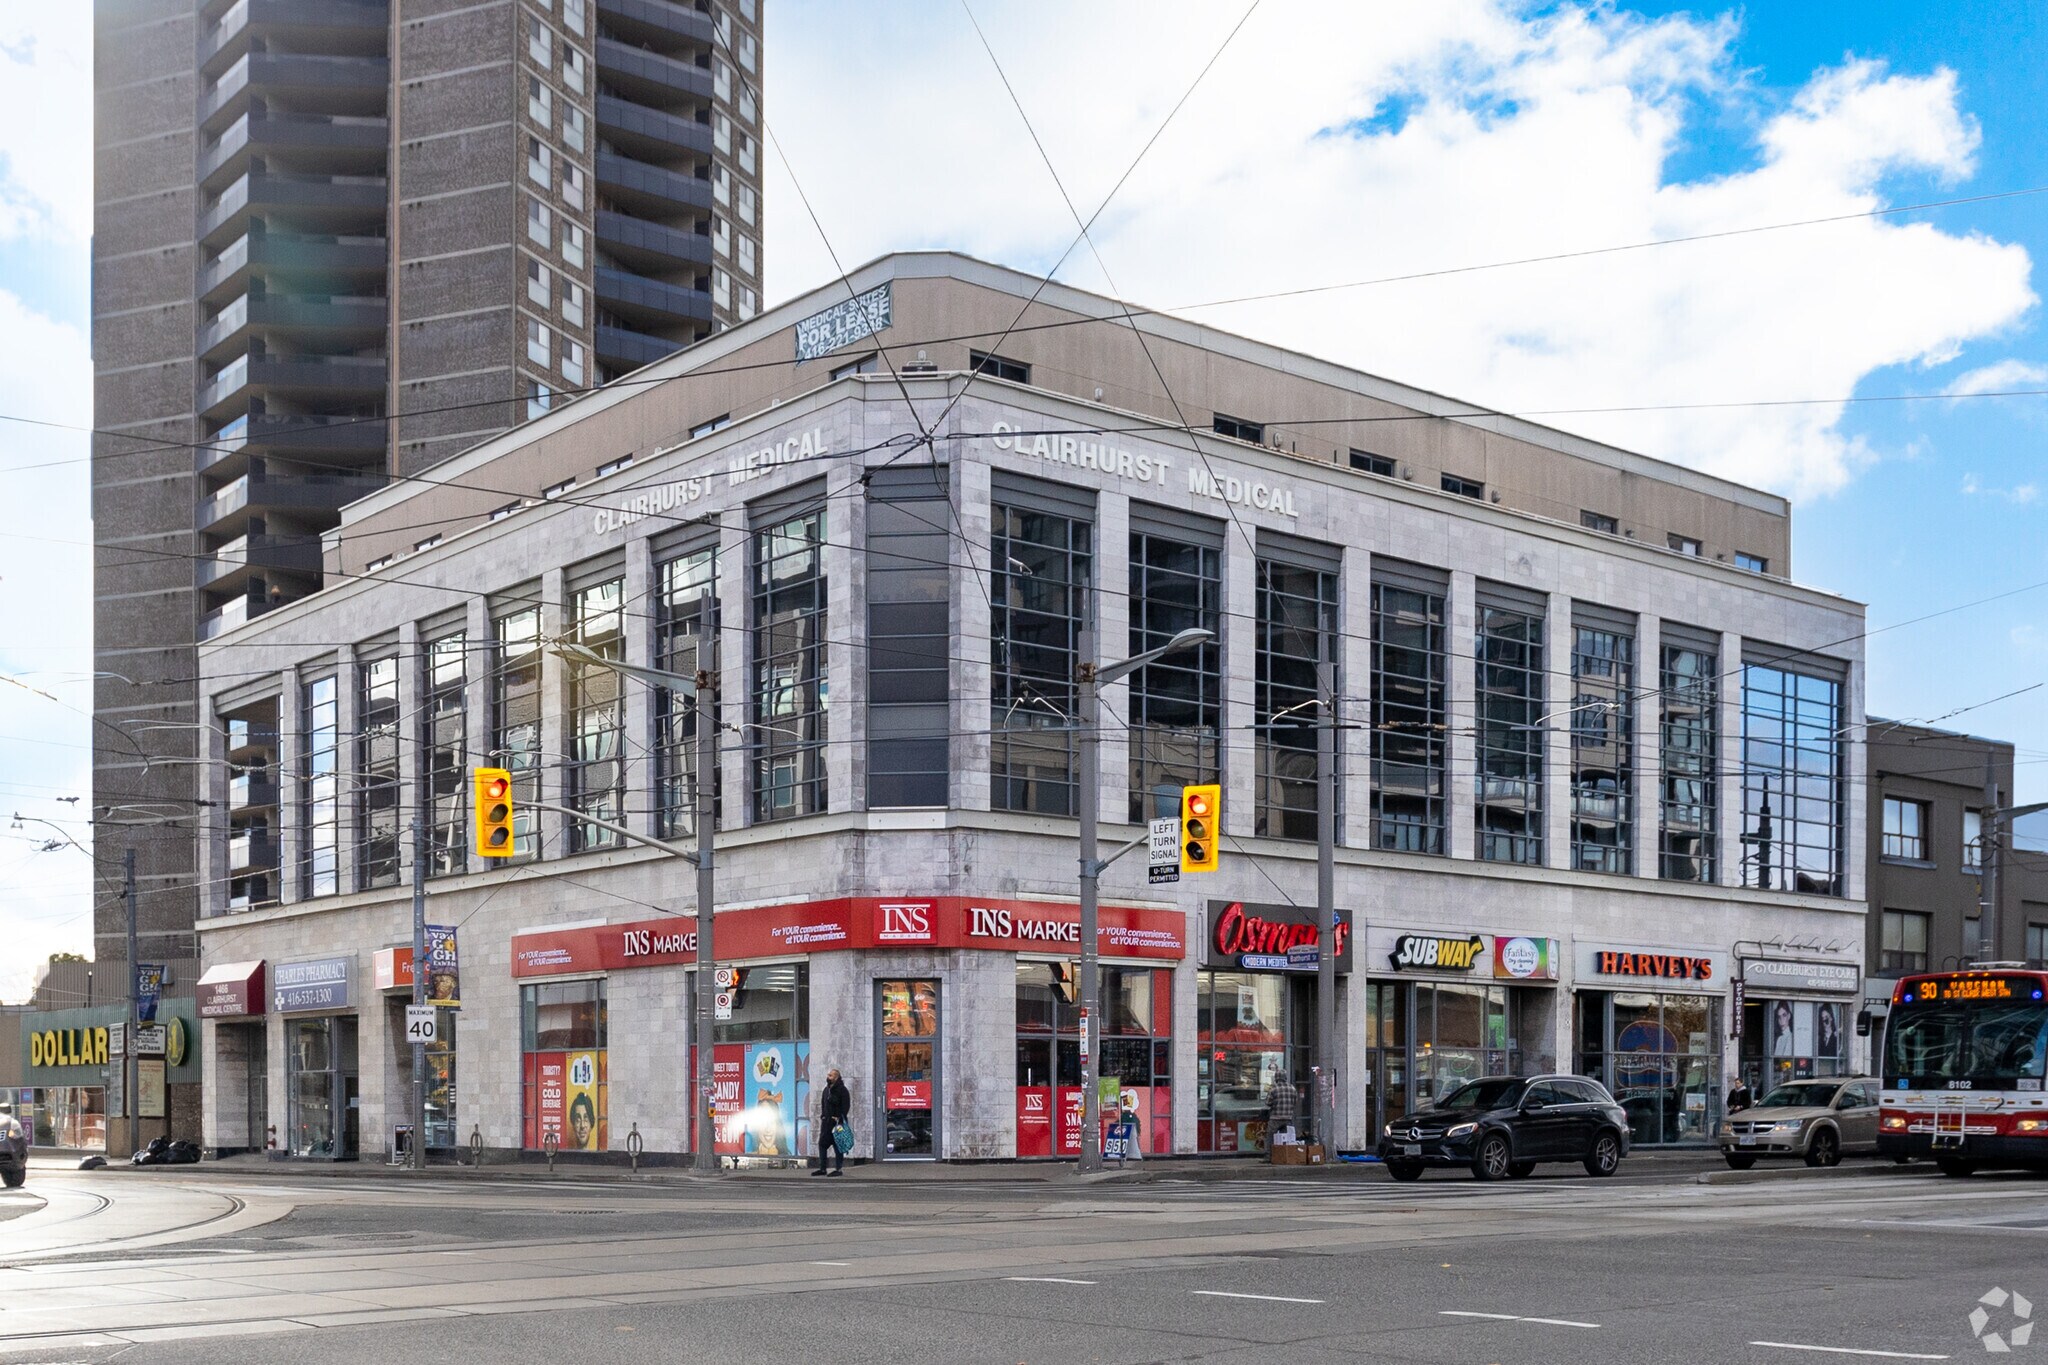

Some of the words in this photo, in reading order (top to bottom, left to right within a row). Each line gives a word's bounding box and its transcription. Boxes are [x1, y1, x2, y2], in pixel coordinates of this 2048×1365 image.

[801, 305, 847, 333] MEDICAL
[849, 286, 886, 311] SUITES
[799, 324, 831, 350] FOR
[836, 297, 890, 333] LEASE
[991, 421, 1170, 485] CLAIRHURST
[1189, 467, 1299, 518] MEDICAL
[593, 468, 715, 535] CLAIRHURST
[729, 428, 828, 487] MEDICAL
[1153, 823, 1175, 834] LEFT
[1153, 836, 1176, 847] TURN
[1150, 848, 1178, 860] SIGNAL
[1153, 866, 1175, 875] U-TURN
[1149, 874, 1179, 883] PERMITTED
[881, 907, 929, 933] INS
[970, 907, 1013, 938] INS
[1017, 919, 1081, 943] MARKE
[771, 927, 782, 937] For
[782, 925, 800, 936] YOUR
[1106, 926, 1127, 936] YOUR
[623, 930, 650, 957] INS
[653, 932, 697, 954] MARKE
[785, 936, 793, 944] at
[793, 933, 811, 944] YOUR
[1110, 937, 1118, 945] at
[1119, 937, 1139, 946] YOUR
[526, 950, 539, 959] YOUR
[1397, 937, 1483, 968] SUBWAY
[534, 958, 546, 966] YOUR
[1244, 957, 1267, 967] MODERN
[1602, 951, 1712, 980] HARVEY'S
[275, 968, 306, 985] CHARLES
[306, 961, 347, 981] PHARMACY
[1768, 962, 1818, 977] CLAIRHURST
[1819, 967, 1835, 978] EYE
[1835, 967, 1857, 980] CARE
[1920, 981, 1938, 999] 90
[207, 994, 237, 1005] CLAIRHURST
[288, 988, 332, 1006] 416-537-1300
[201, 1005, 222, 1014] MEDICAL
[223, 1004, 242, 1014] CENTRE
[1735, 982, 1743, 1034] OPTOMETRIST
[409, 1021, 434, 1038] 40
[31, 1027, 108, 1067] DOLLAR
[1948, 1080, 1972, 1090] 8102
[542, 1088, 561, 1099] COLD
[715, 1102, 740, 1112] HOCOLATE
[1066, 1112, 1082, 1126] SNA
